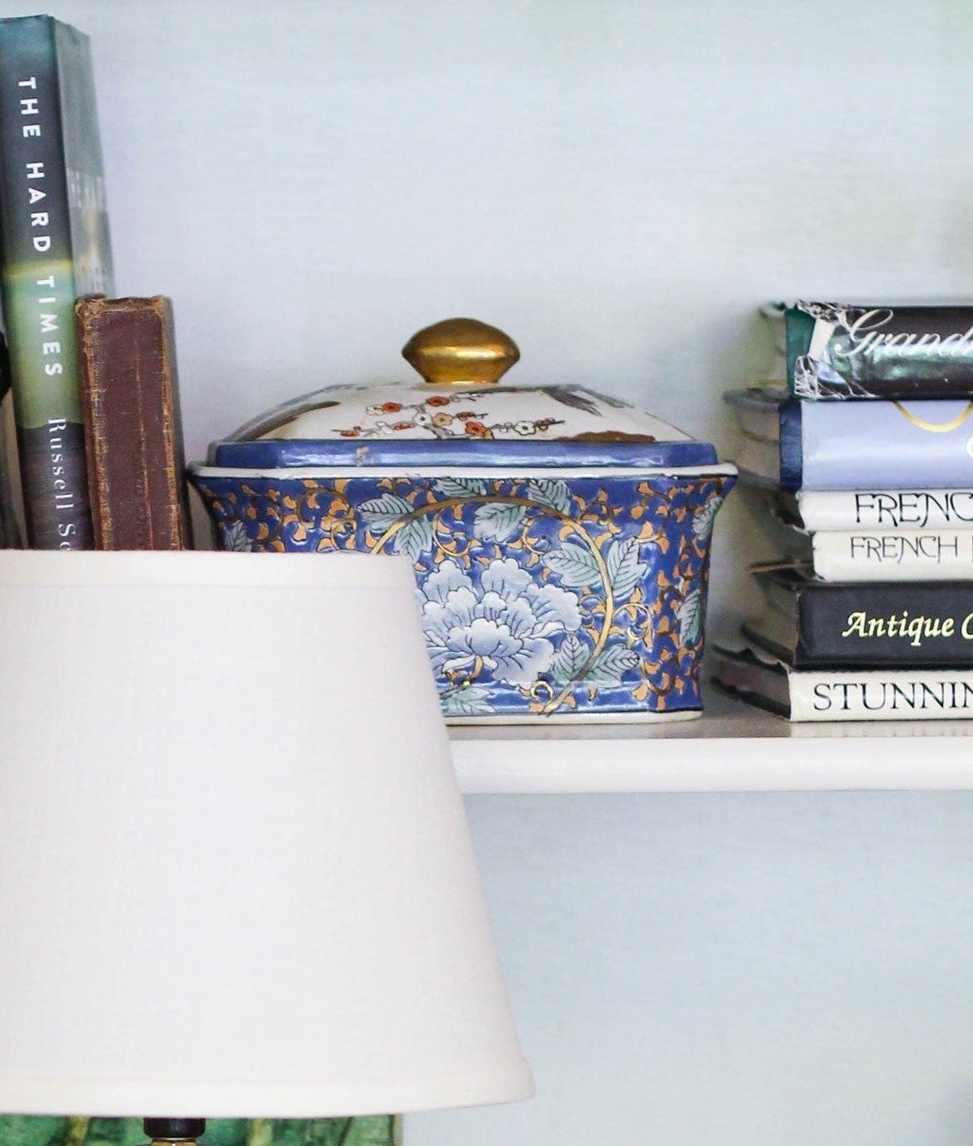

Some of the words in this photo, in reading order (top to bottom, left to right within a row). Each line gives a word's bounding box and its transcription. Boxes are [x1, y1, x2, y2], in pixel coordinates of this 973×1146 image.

[18, 77, 42, 138] THE
[26, 162, 52, 253] HARD
[37, 275, 64, 377] TIMES
[48, 418, 74, 509] Russell
[850, 535, 958, 564] FRENCH
[841, 610, 955, 646] Antique
